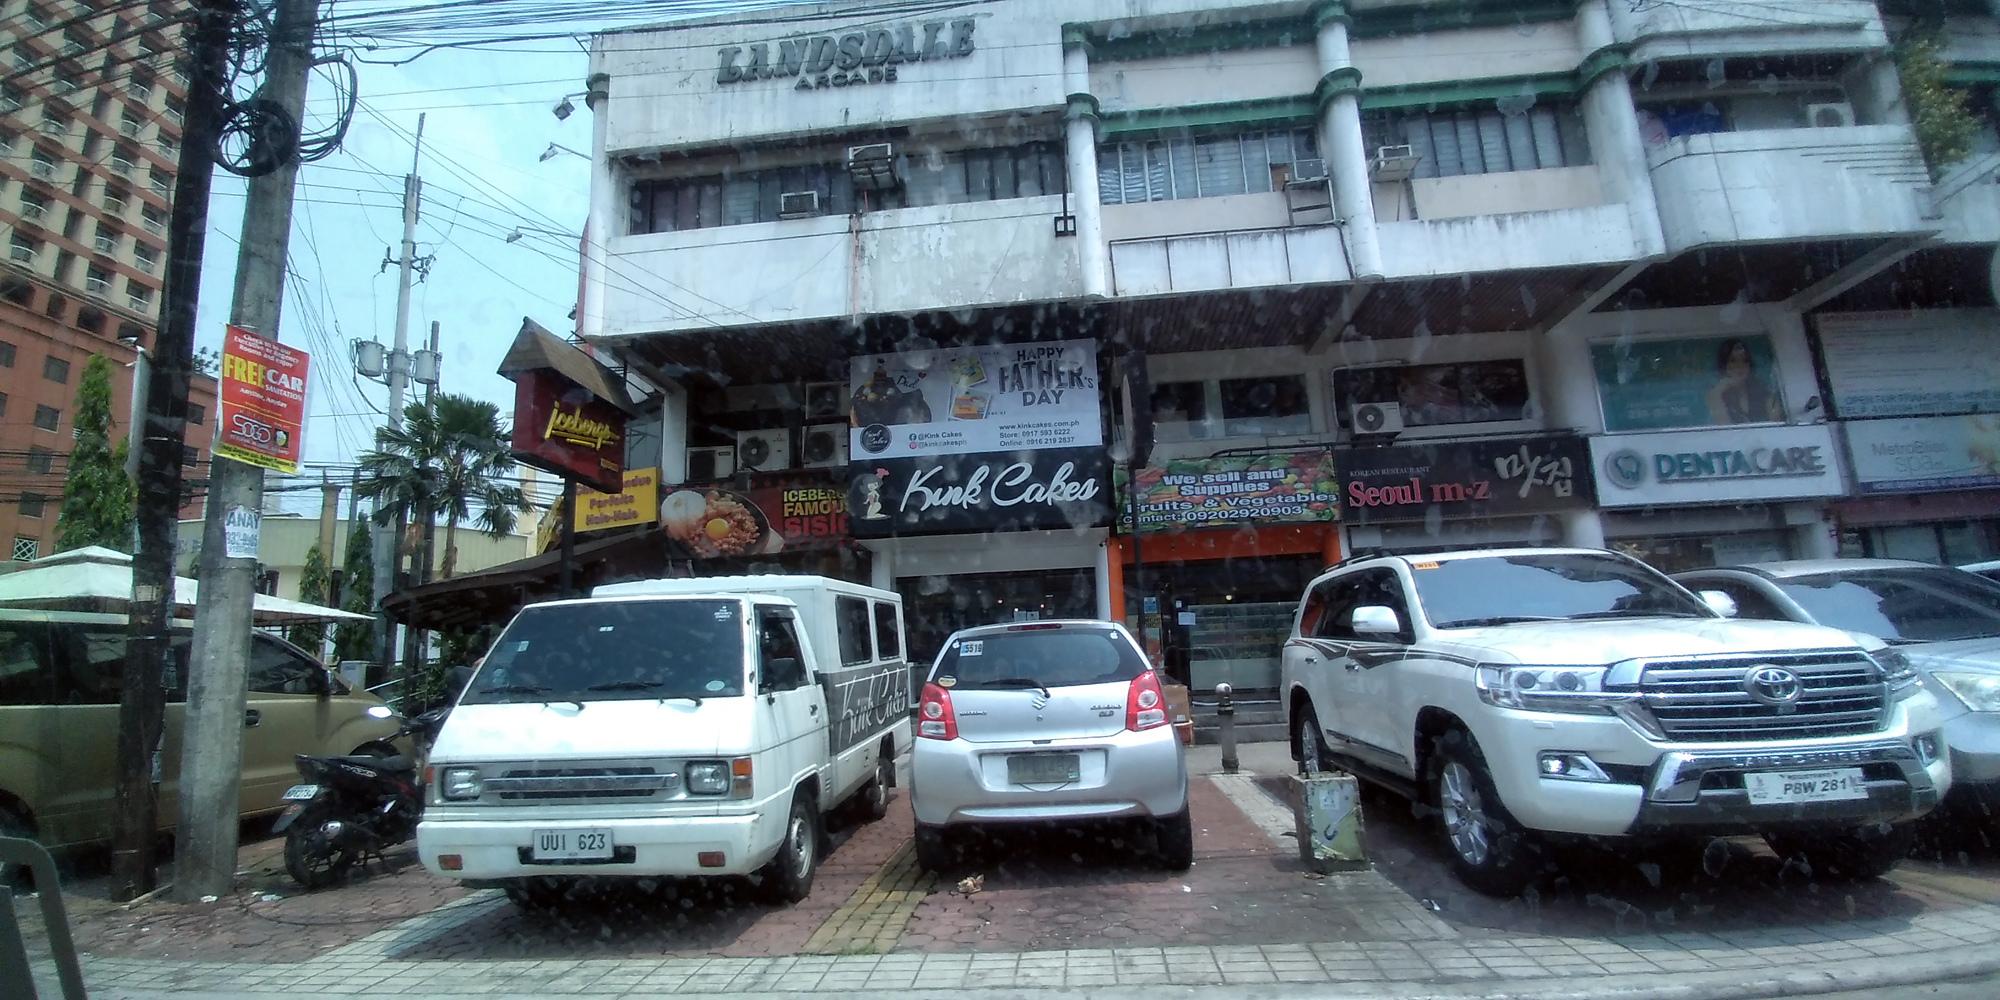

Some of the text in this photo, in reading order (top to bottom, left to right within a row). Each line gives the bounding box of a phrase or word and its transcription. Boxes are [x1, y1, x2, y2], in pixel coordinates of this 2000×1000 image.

[717, 18, 976, 85] LANDSDALE
[794, 66, 898, 91] ARCADE
[1017, 347, 1065, 362] HAPPY
[223, 353, 304, 393] FREE CAR
[265, 384, 303, 402] SANITATION
[1022, 389, 1065, 407] DAY
[999, 420, 1080, 431] www.kinkcakes.com.ph
[941, 431, 963, 439] Cakes
[999, 431, 1020, 439] Store:
[1654, 445, 1826, 477] DENTACARE
[1163, 468, 1285, 486] We sell and
[900, 461, 1100, 512] Kink Cakes
[1180, 482, 1270, 496] Supplies
[1348, 477, 1424, 508] Seoul
[1204, 497, 1220, 508] &
[1225, 493, 1338, 507] Vegetables
[227, 511, 260, 529] ANAY
[1187, 506, 1303, 521] 09202920903
[1821, 778, 1847, 792] 281
[578, 833, 605, 850] 623
